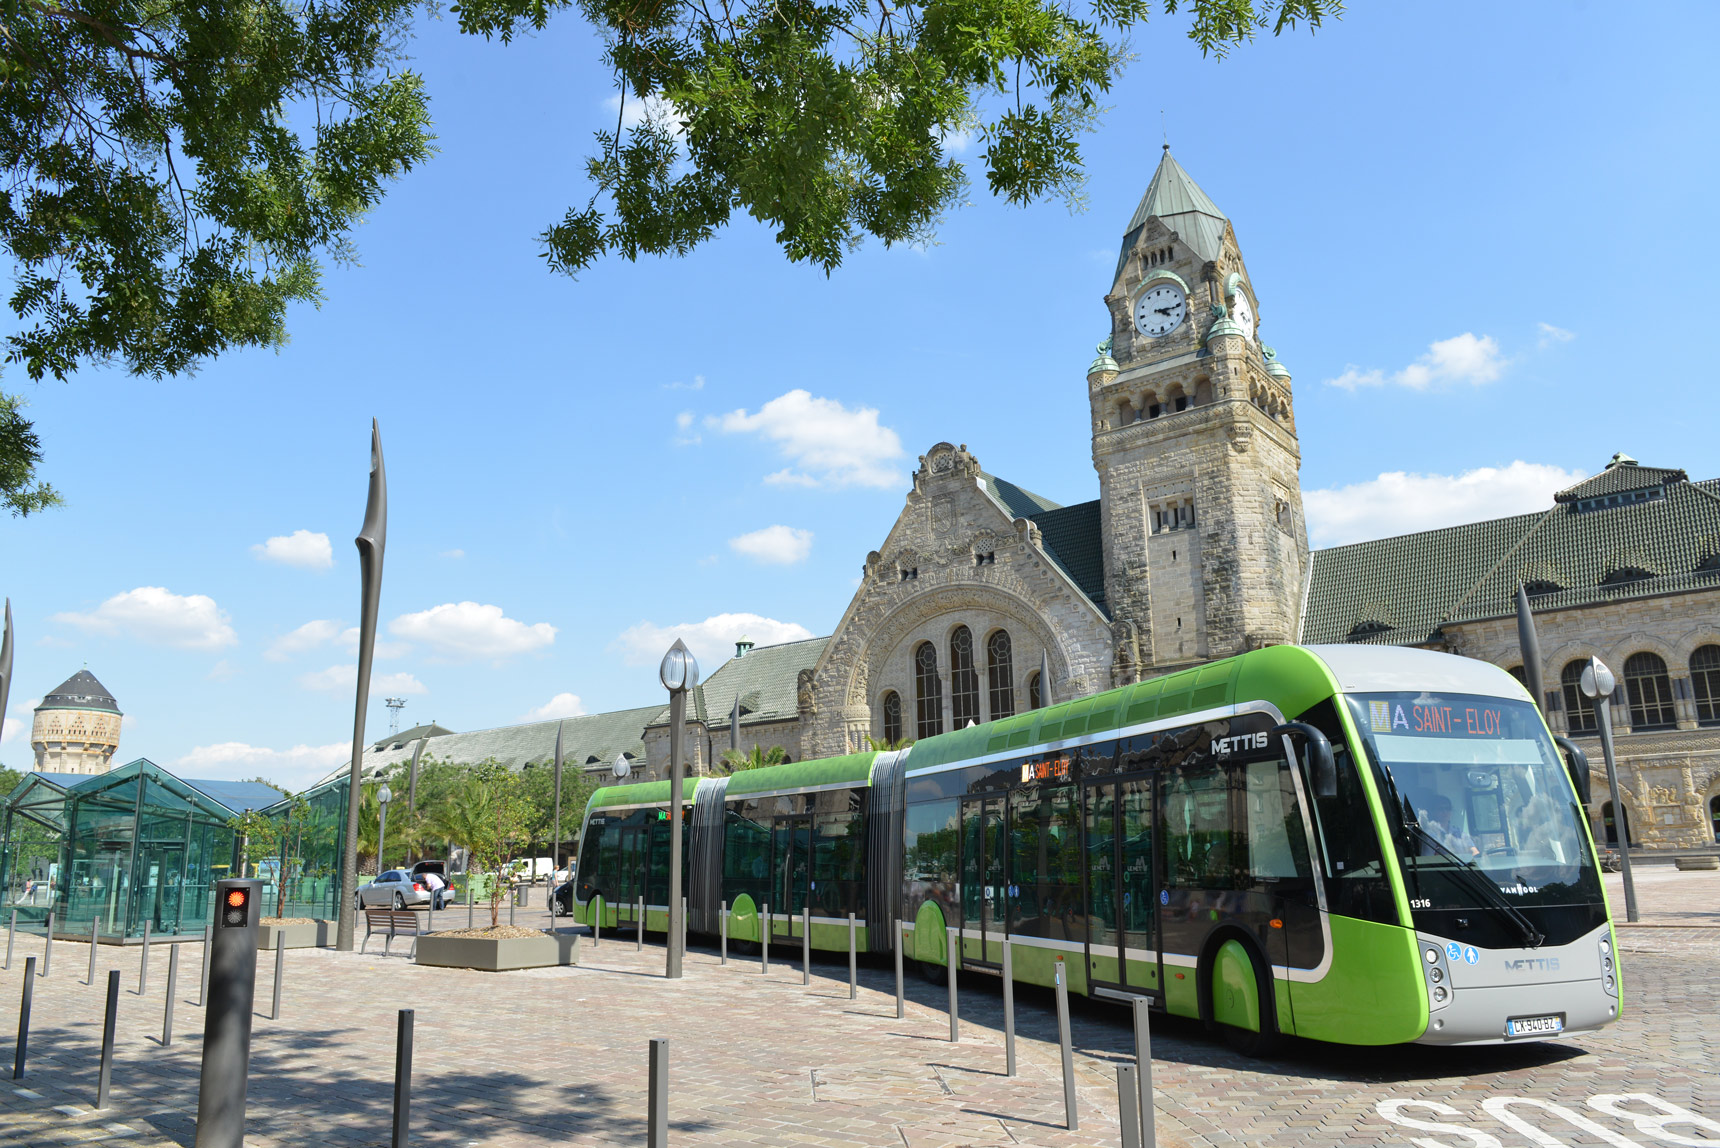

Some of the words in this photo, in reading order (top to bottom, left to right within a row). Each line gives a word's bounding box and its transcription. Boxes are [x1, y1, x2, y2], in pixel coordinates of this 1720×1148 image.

[1211, 731, 1268, 755] METTIS
[1410, 899, 1431, 908] 1316
[1504, 957, 1560, 973] METTIS
